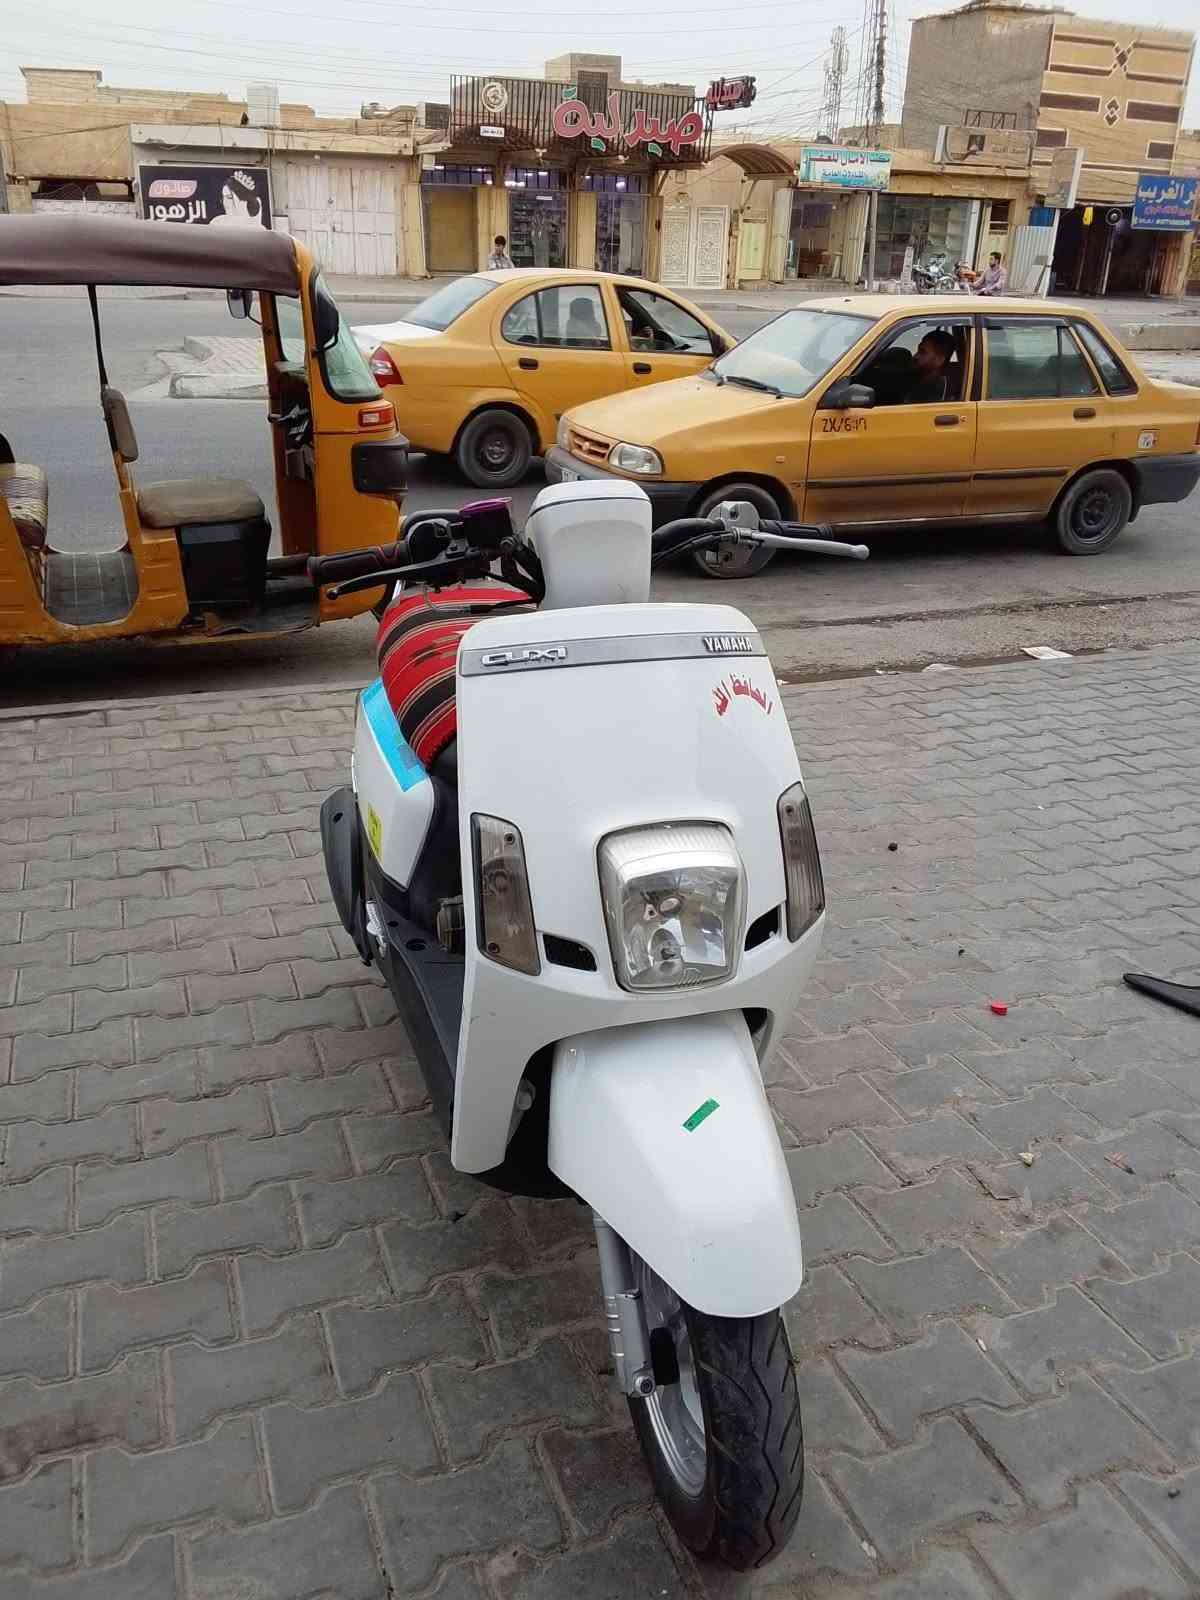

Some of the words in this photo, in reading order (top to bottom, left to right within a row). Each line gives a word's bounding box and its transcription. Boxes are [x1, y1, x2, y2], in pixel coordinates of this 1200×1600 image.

[553, 84, 704, 157] صيدلية
[155, 183, 193, 197] صالون
[148, 199, 207, 223] الزهور
[703, 636, 753, 652] YAMAHA
